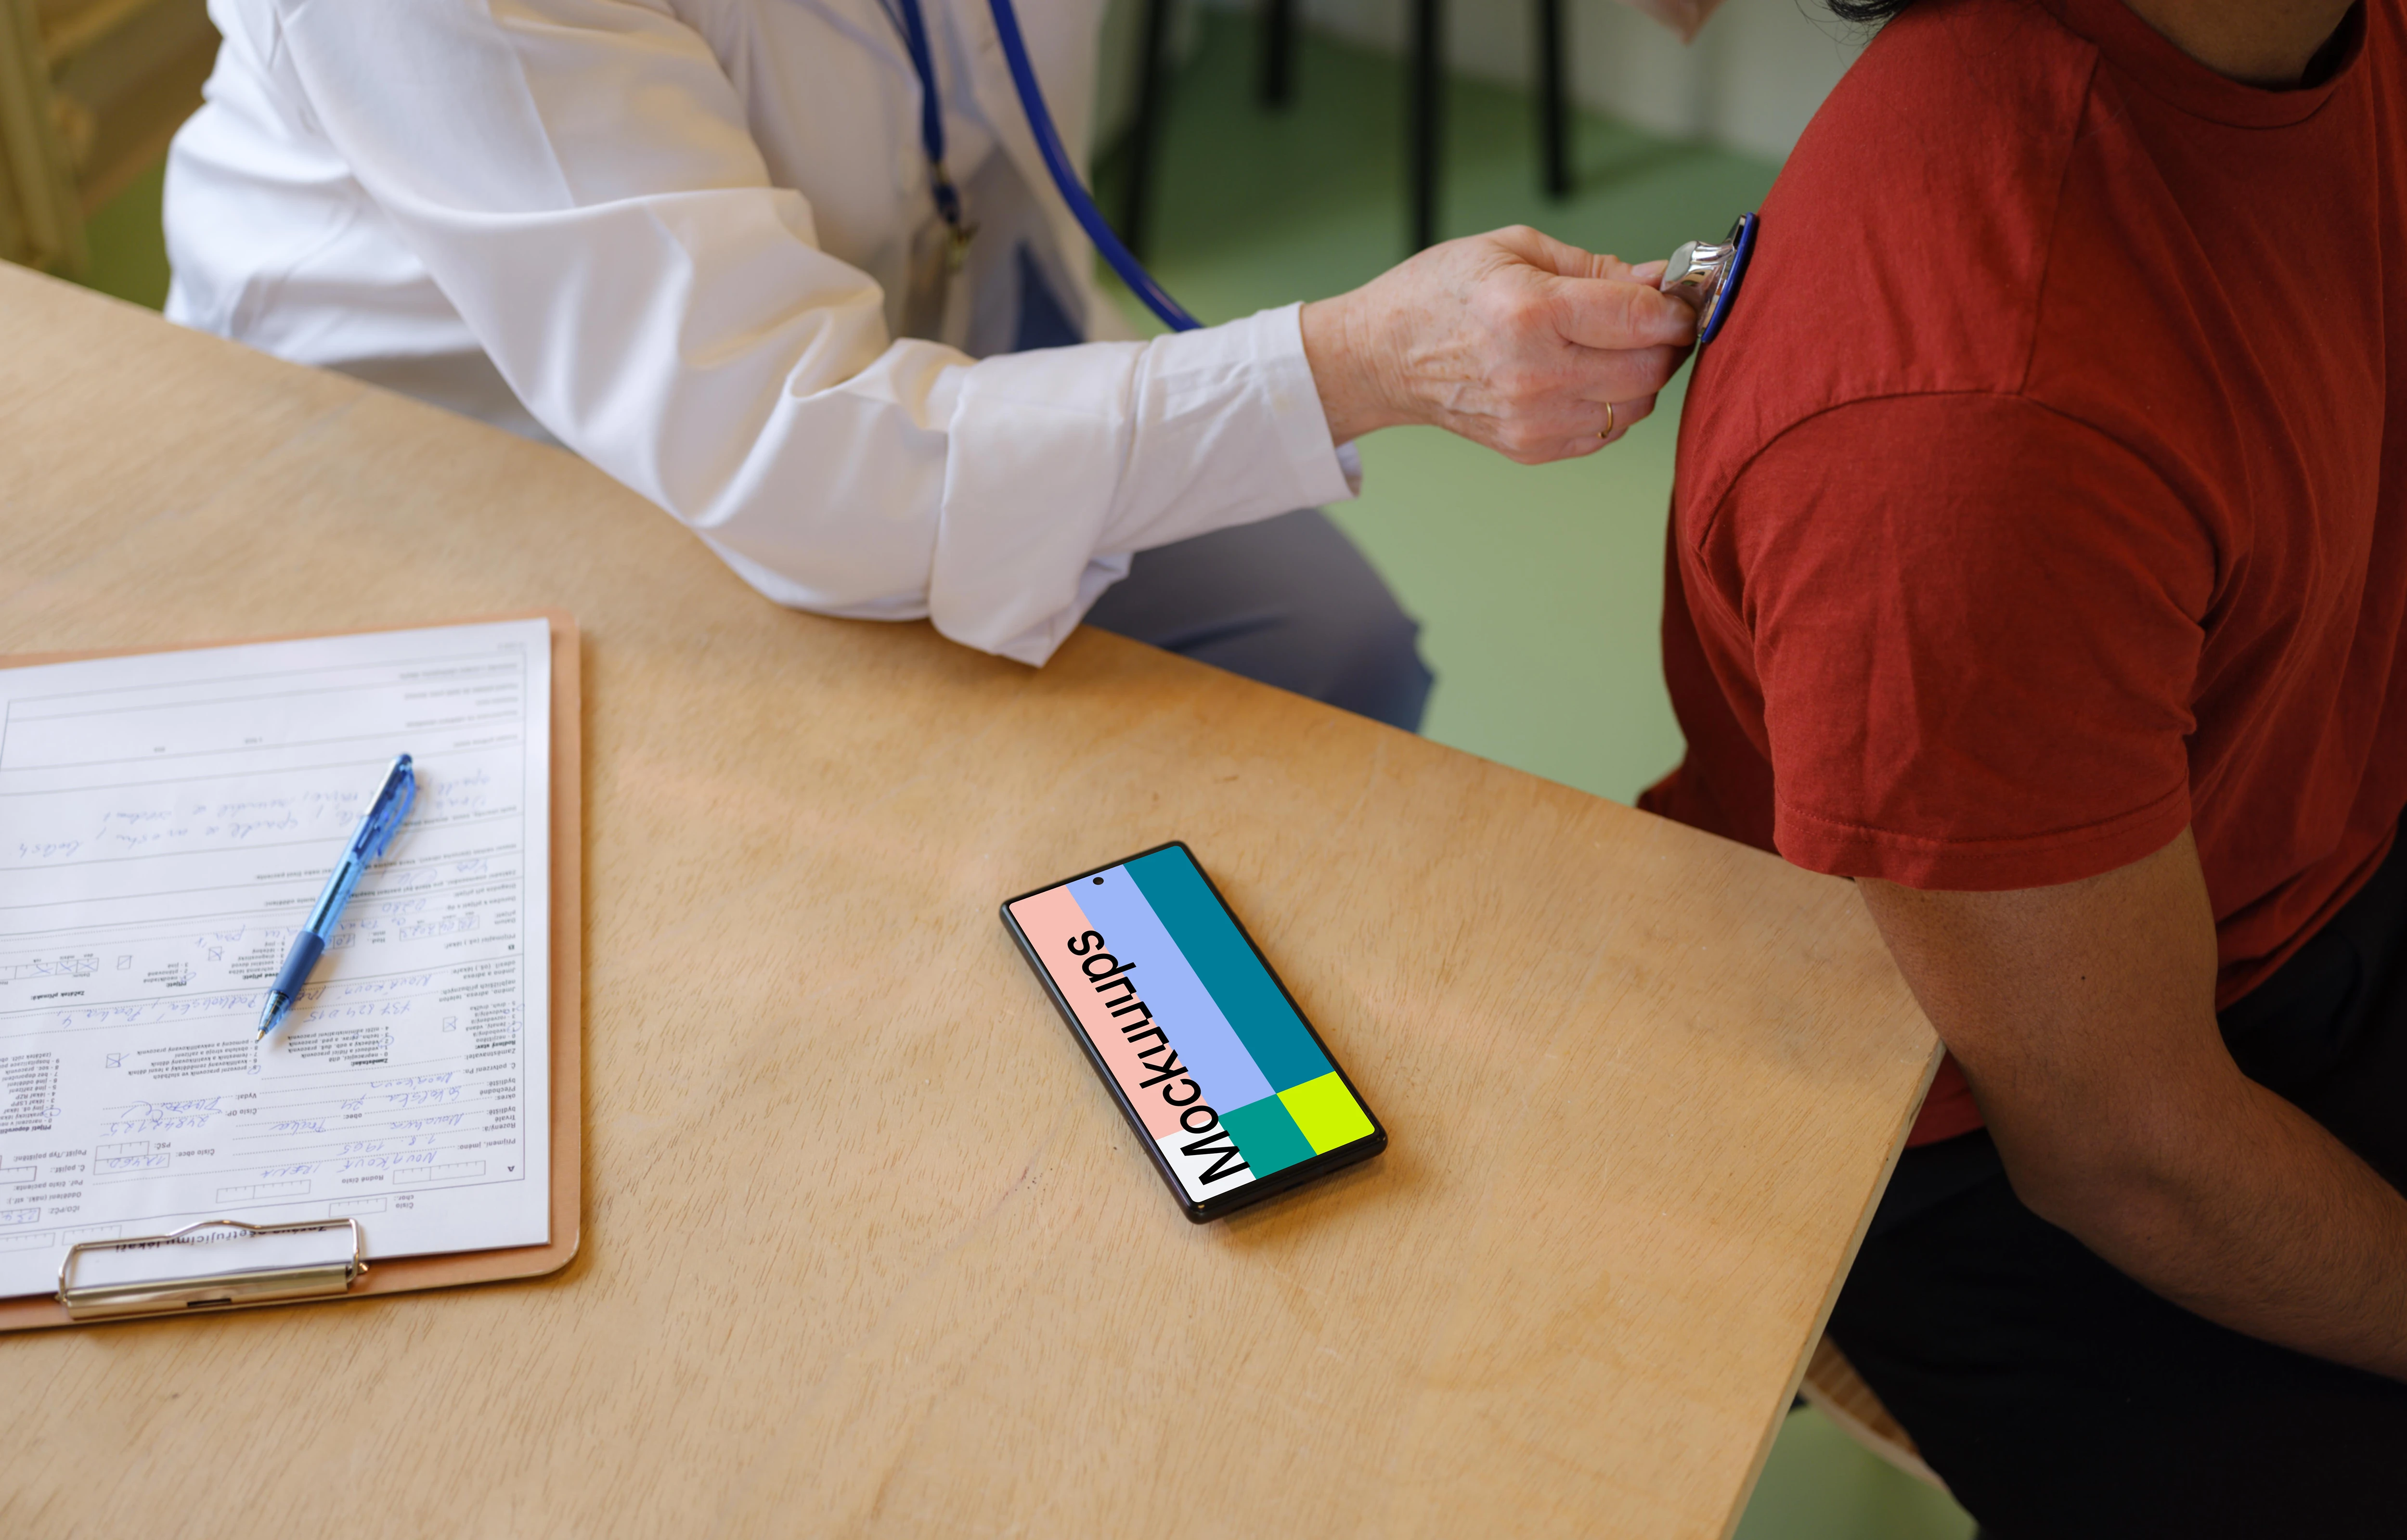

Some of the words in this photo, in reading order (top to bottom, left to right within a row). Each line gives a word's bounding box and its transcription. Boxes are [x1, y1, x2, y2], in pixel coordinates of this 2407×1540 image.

[440, 984, 478, 994] příbuzných:
[480, 979, 516, 990] nejbližších
[439, 993, 462, 1002] telefon
[471, 1015, 506, 1024] rozvedený/á
[484, 1021, 506, 1030] ženatý,
[318, 1028, 364, 1039] administrativní
[288, 1039, 318, 1047] pracovník
[476, 1034, 506, 1043] nezjištěno
[168, 1043, 215, 1053] nekvalifikovaný
[492, 1040, 516, 1048] Rodinný
[137, 1048, 166, 1056] pracovník
[288, 1045, 317, 1053] pracovník
[464, 1048, 516, 1059] Zaměstnavatel:
[218, 1052, 247, 1060] řemeslník
[301, 1050, 330, 1058] pracovník
[343, 1052, 378, 1061] nepracující,
[1067, 930, 1250, 1185] Mockuuups
[10, 1059, 50, 1067] hospitalizace
[171, 1056, 211, 1065] kvalifikovaný
[207, 1059, 247, 1068] kvalifikovaný
[350, 1058, 388, 1066] Zaměstnání:
[5, 1066, 34, 1075] pracovník
[170, 1063, 207, 1071] zemědělský
[221, 1065, 246, 1073] provozní
[476, 1063, 506, 1073] potvrzení
[191, 1068, 220, 1076] pracovník
[2, 1073, 36, 1081] doporučení
[479, 1086, 516, 1095] Přechodné
[486, 1106, 516, 1115] bydliště:
[482, 1121, 516, 1131] Rozený/á:
[457, 1142, 481, 1150] jméno:
[484, 1138, 516, 1147] Příjmení,
[13, 1152, 47, 1162] pojištění:
[77, 1164, 85, 1172] Č.
[13, 1182, 46, 1191] pacienta:
[26, 1194, 47, 1203] (nákl.
[49, 1192, 81, 1201] Oddělení
[48, 1205, 80, 1214] IČO/PČZ:
